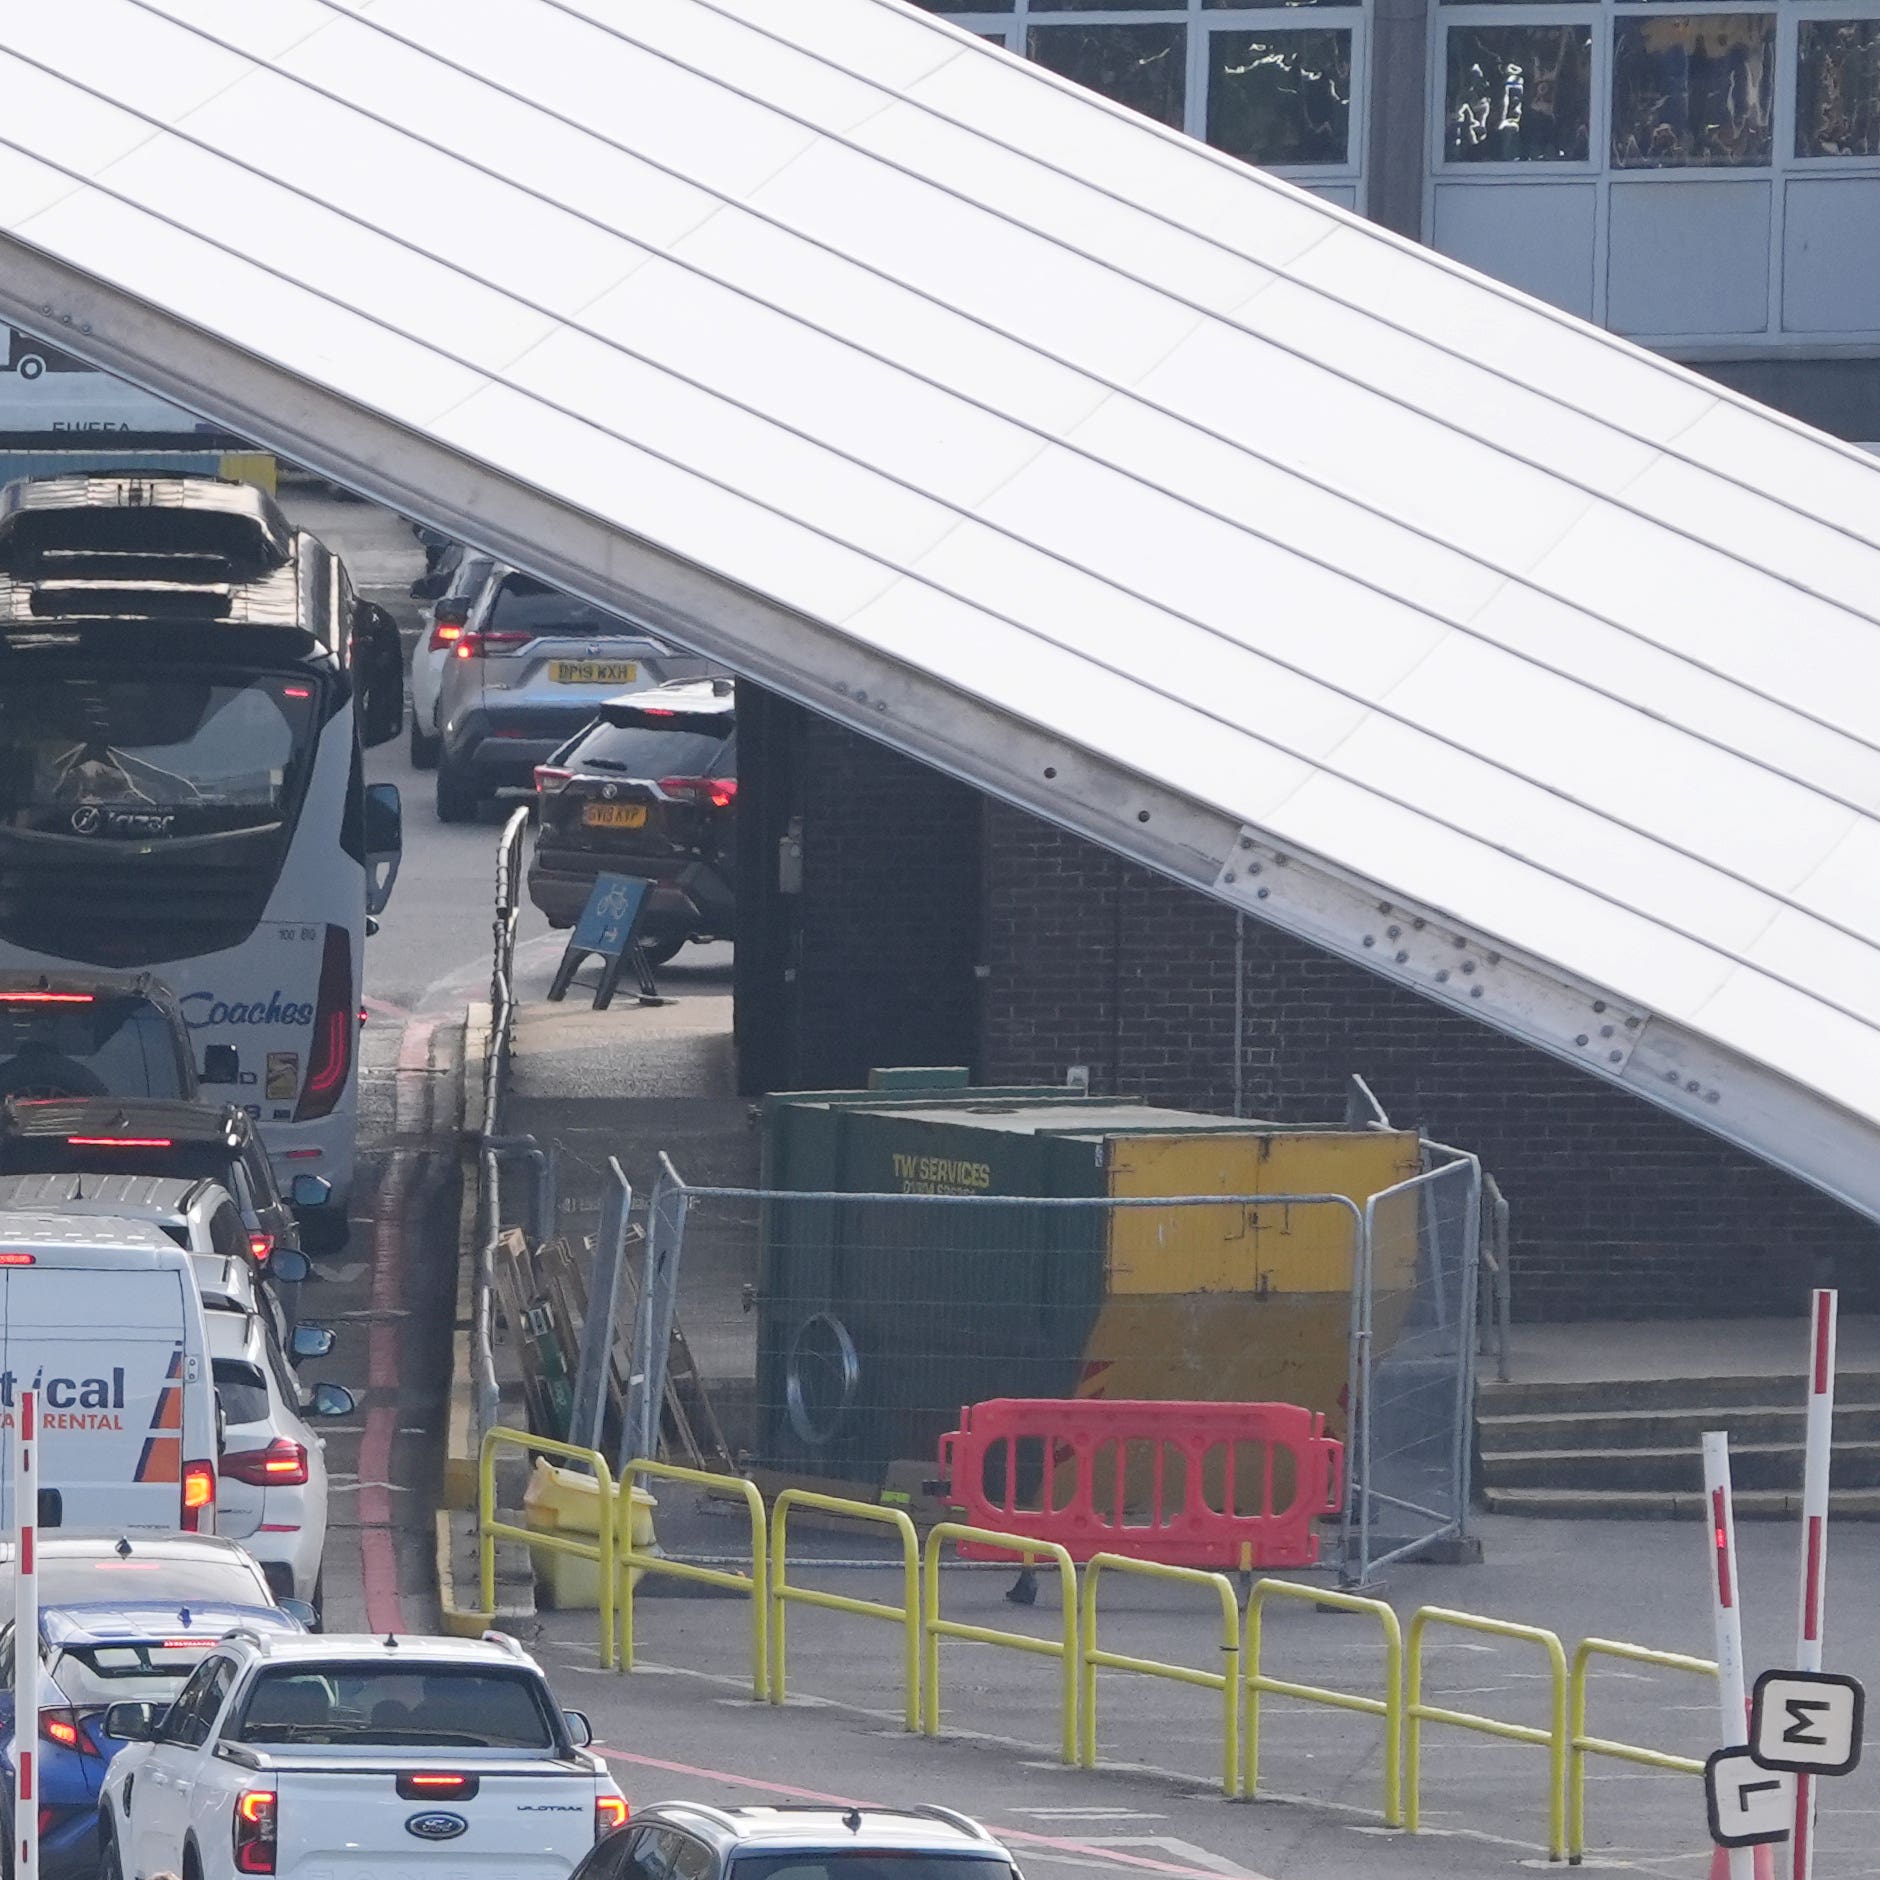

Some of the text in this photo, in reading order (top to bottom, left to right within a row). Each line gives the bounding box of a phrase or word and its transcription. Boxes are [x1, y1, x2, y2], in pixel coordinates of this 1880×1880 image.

[180, 990, 313, 1029] Coaches
[893, 1153, 990, 1186] TW SERVICES
[43, 1413, 123, 1431] RENTAL
[1783, 1698, 1830, 1745] M
[1738, 1779, 1781, 1812] L
